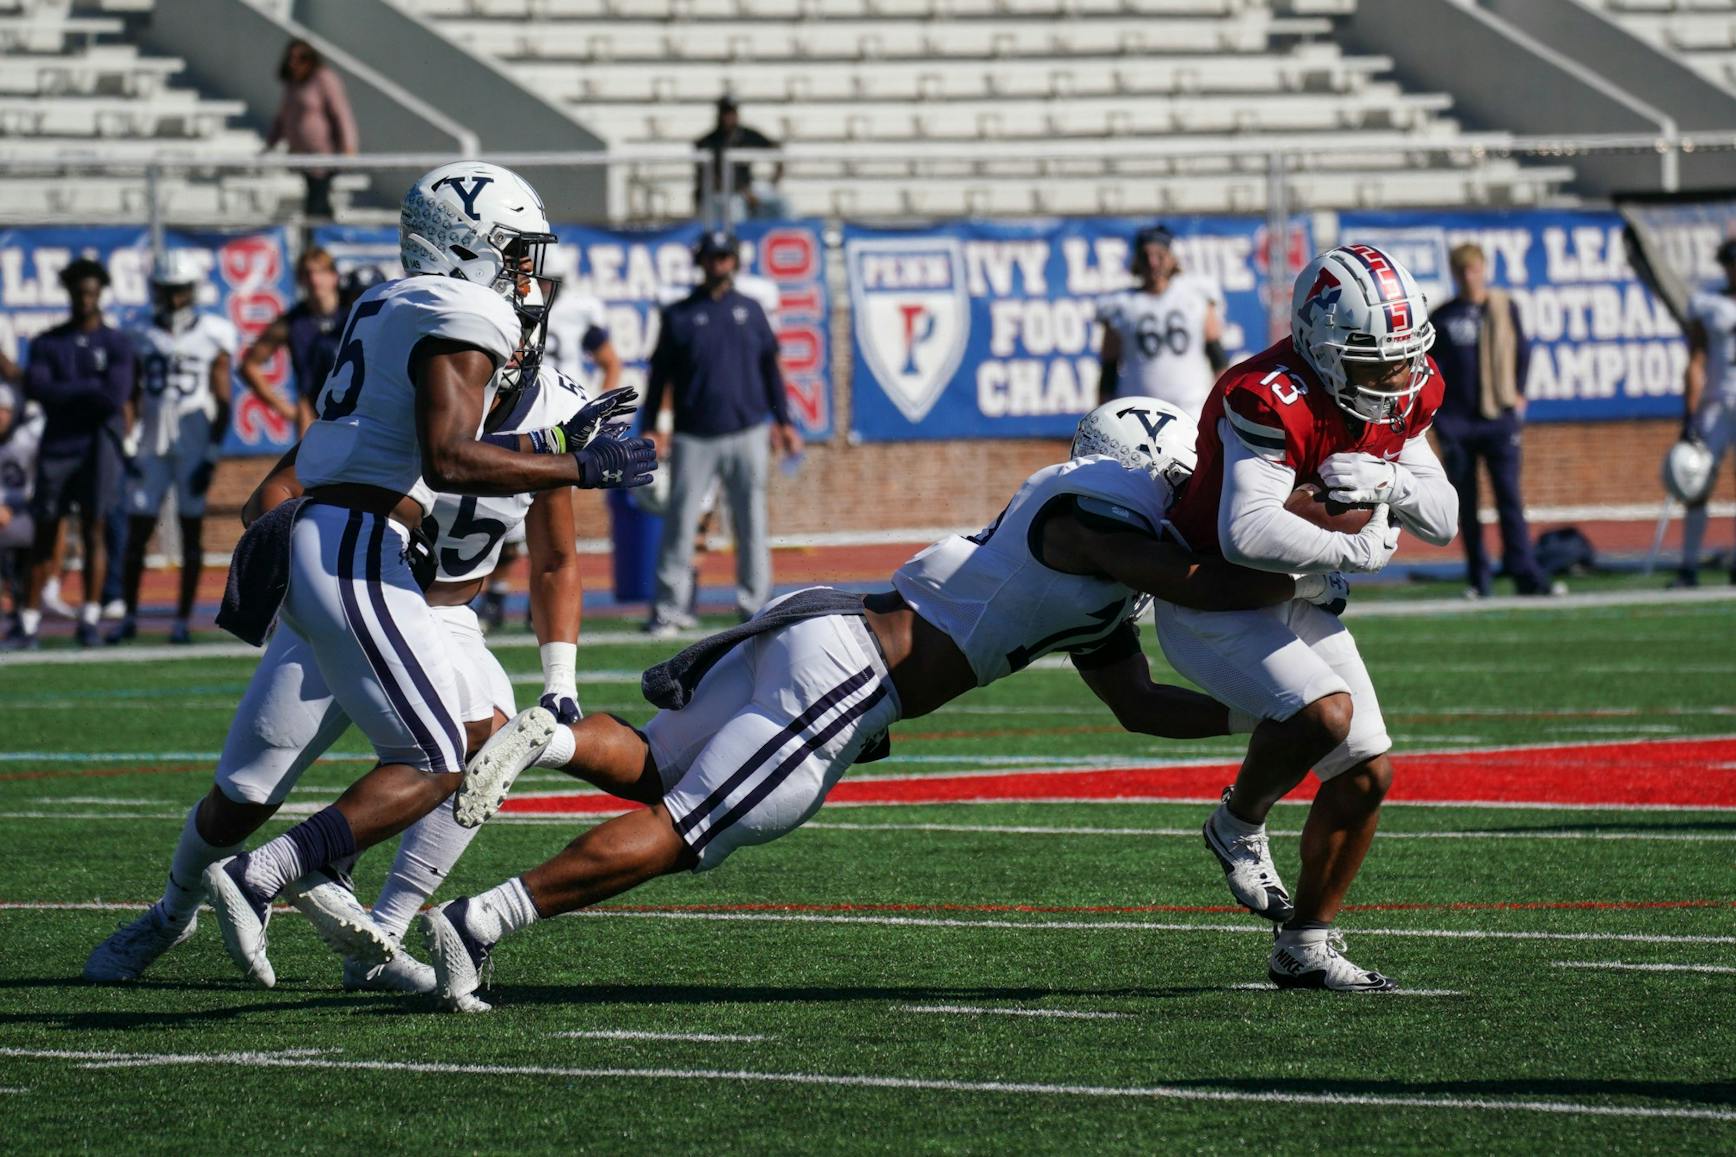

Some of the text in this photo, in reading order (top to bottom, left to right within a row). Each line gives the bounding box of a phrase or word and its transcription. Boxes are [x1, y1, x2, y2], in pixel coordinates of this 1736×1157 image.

[446, 176, 494, 221] Y
[1, 246, 218, 307] LEGE
[864, 255, 949, 288] PENN
[966, 241, 1048, 297] IVY
[1063, 233, 1255, 292] LEUE
[1449, 228, 1531, 285] VY
[899, 305, 936, 375] P
[1136, 310, 1190, 361] 66
[145, 354, 200, 398] 85
[1260, 364, 1309, 405] 13
[1525, 344, 1690, 399] AMPION
[1132, 408, 1178, 455] Y
[1275, 949, 1305, 977] NIKE
